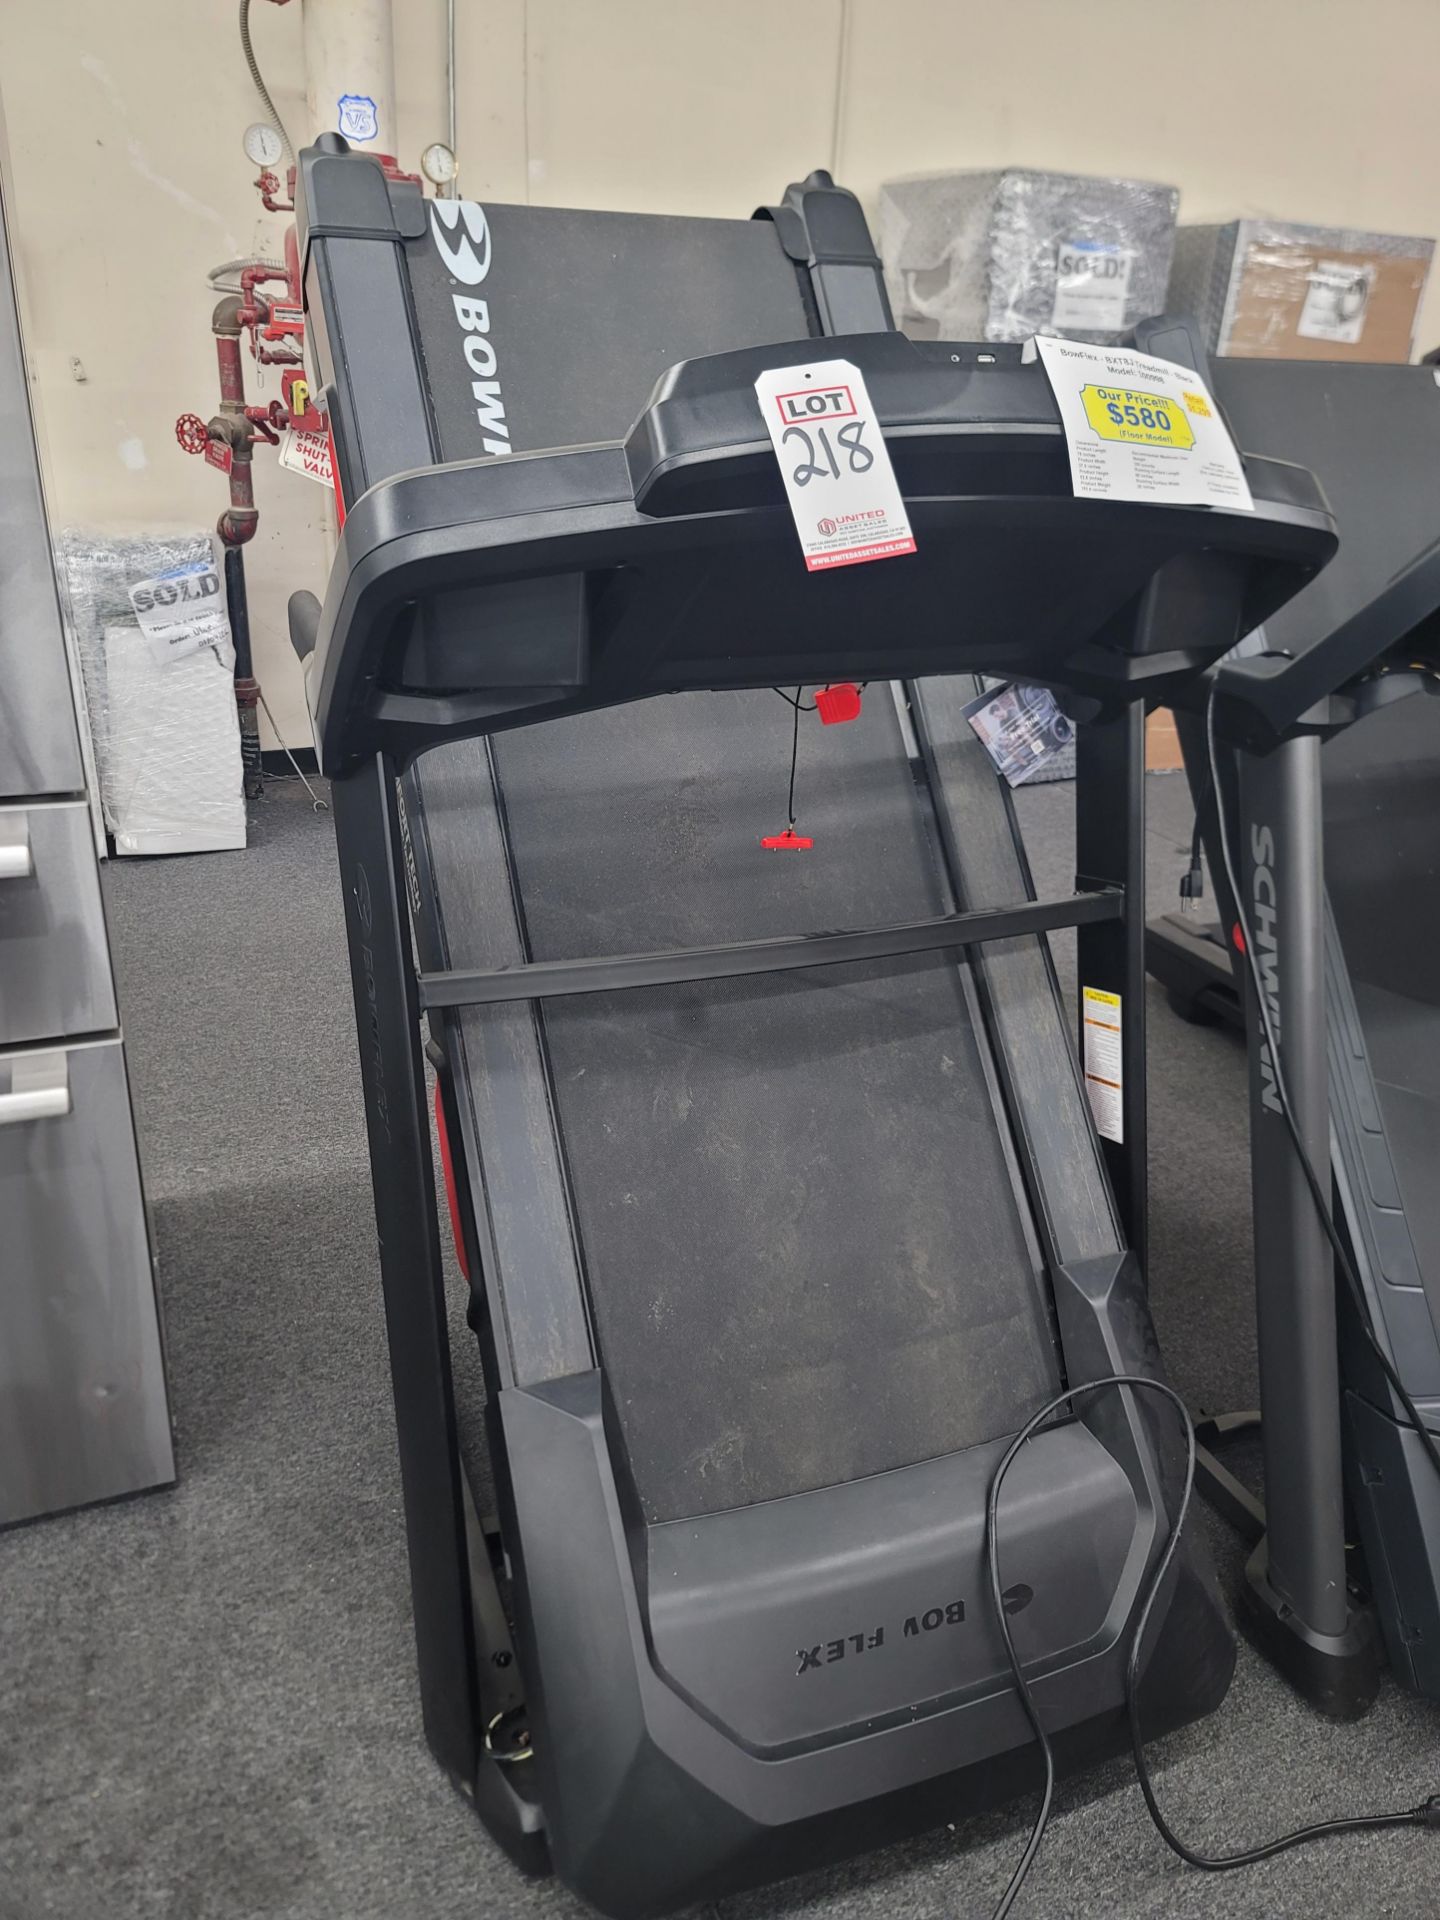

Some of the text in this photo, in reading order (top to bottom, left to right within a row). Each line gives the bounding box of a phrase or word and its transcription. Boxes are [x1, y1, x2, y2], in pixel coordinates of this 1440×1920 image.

[787, 392, 843, 417] LOT
[1098, 389, 1169, 410] Our Price!!!
[1107, 402, 1171, 431] $580
[782, 421, 874, 487] 218
[835, 509, 884, 524] UNITED
[133, 573, 220, 613] SOLD
[1252, 823, 1283, 1115] SCHWINN
